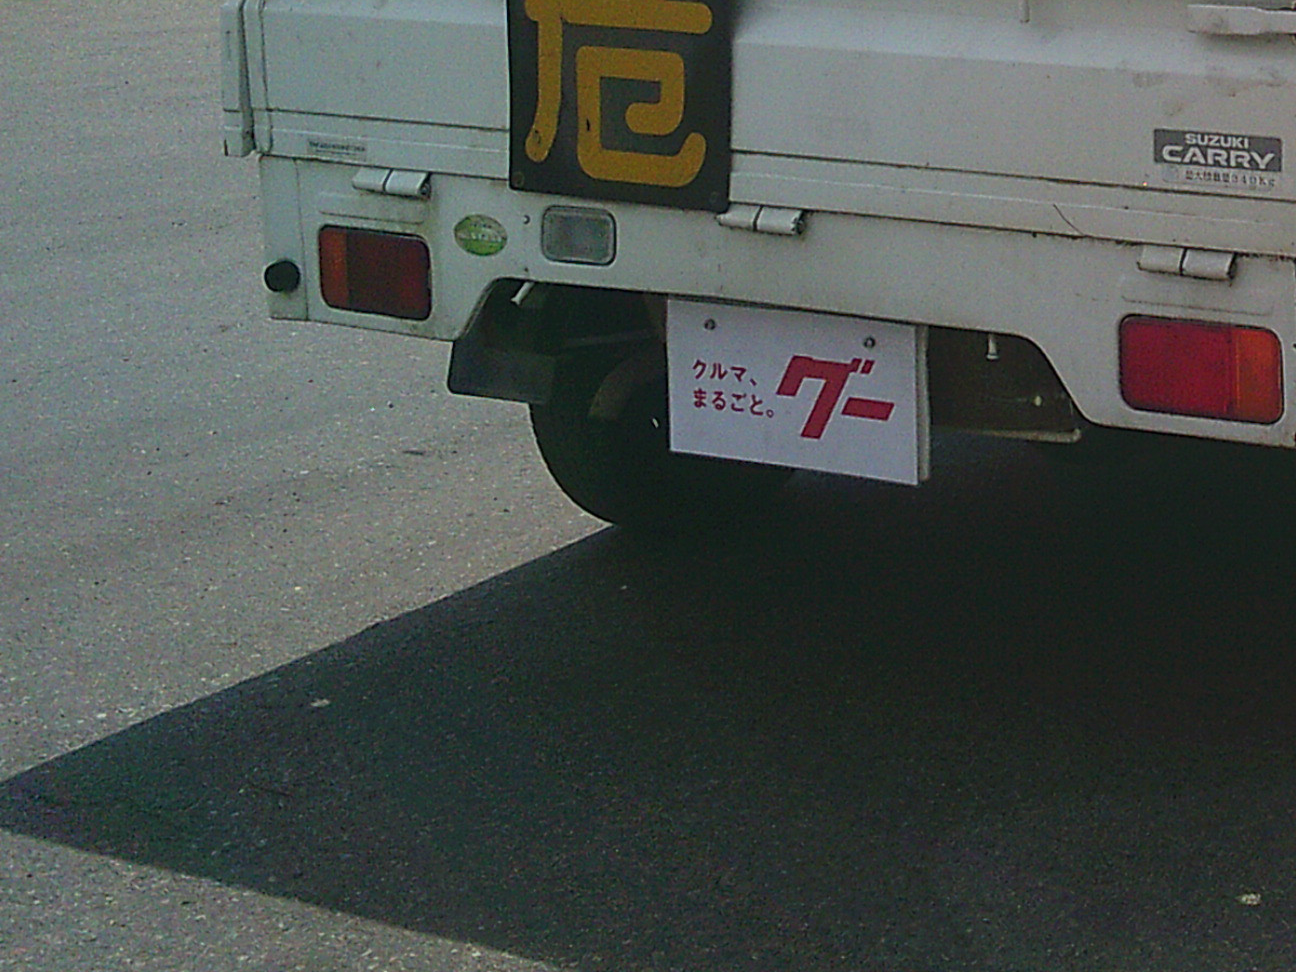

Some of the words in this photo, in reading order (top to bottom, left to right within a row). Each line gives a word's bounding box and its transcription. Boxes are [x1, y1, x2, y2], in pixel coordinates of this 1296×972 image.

[1184, 132, 1249, 149] SUZUKI
[1162, 145, 1275, 169] CARRY
[692, 359, 758, 386] クルマ、
[692, 388, 774, 418] まるごと。
[775, 354, 896, 440] グー
